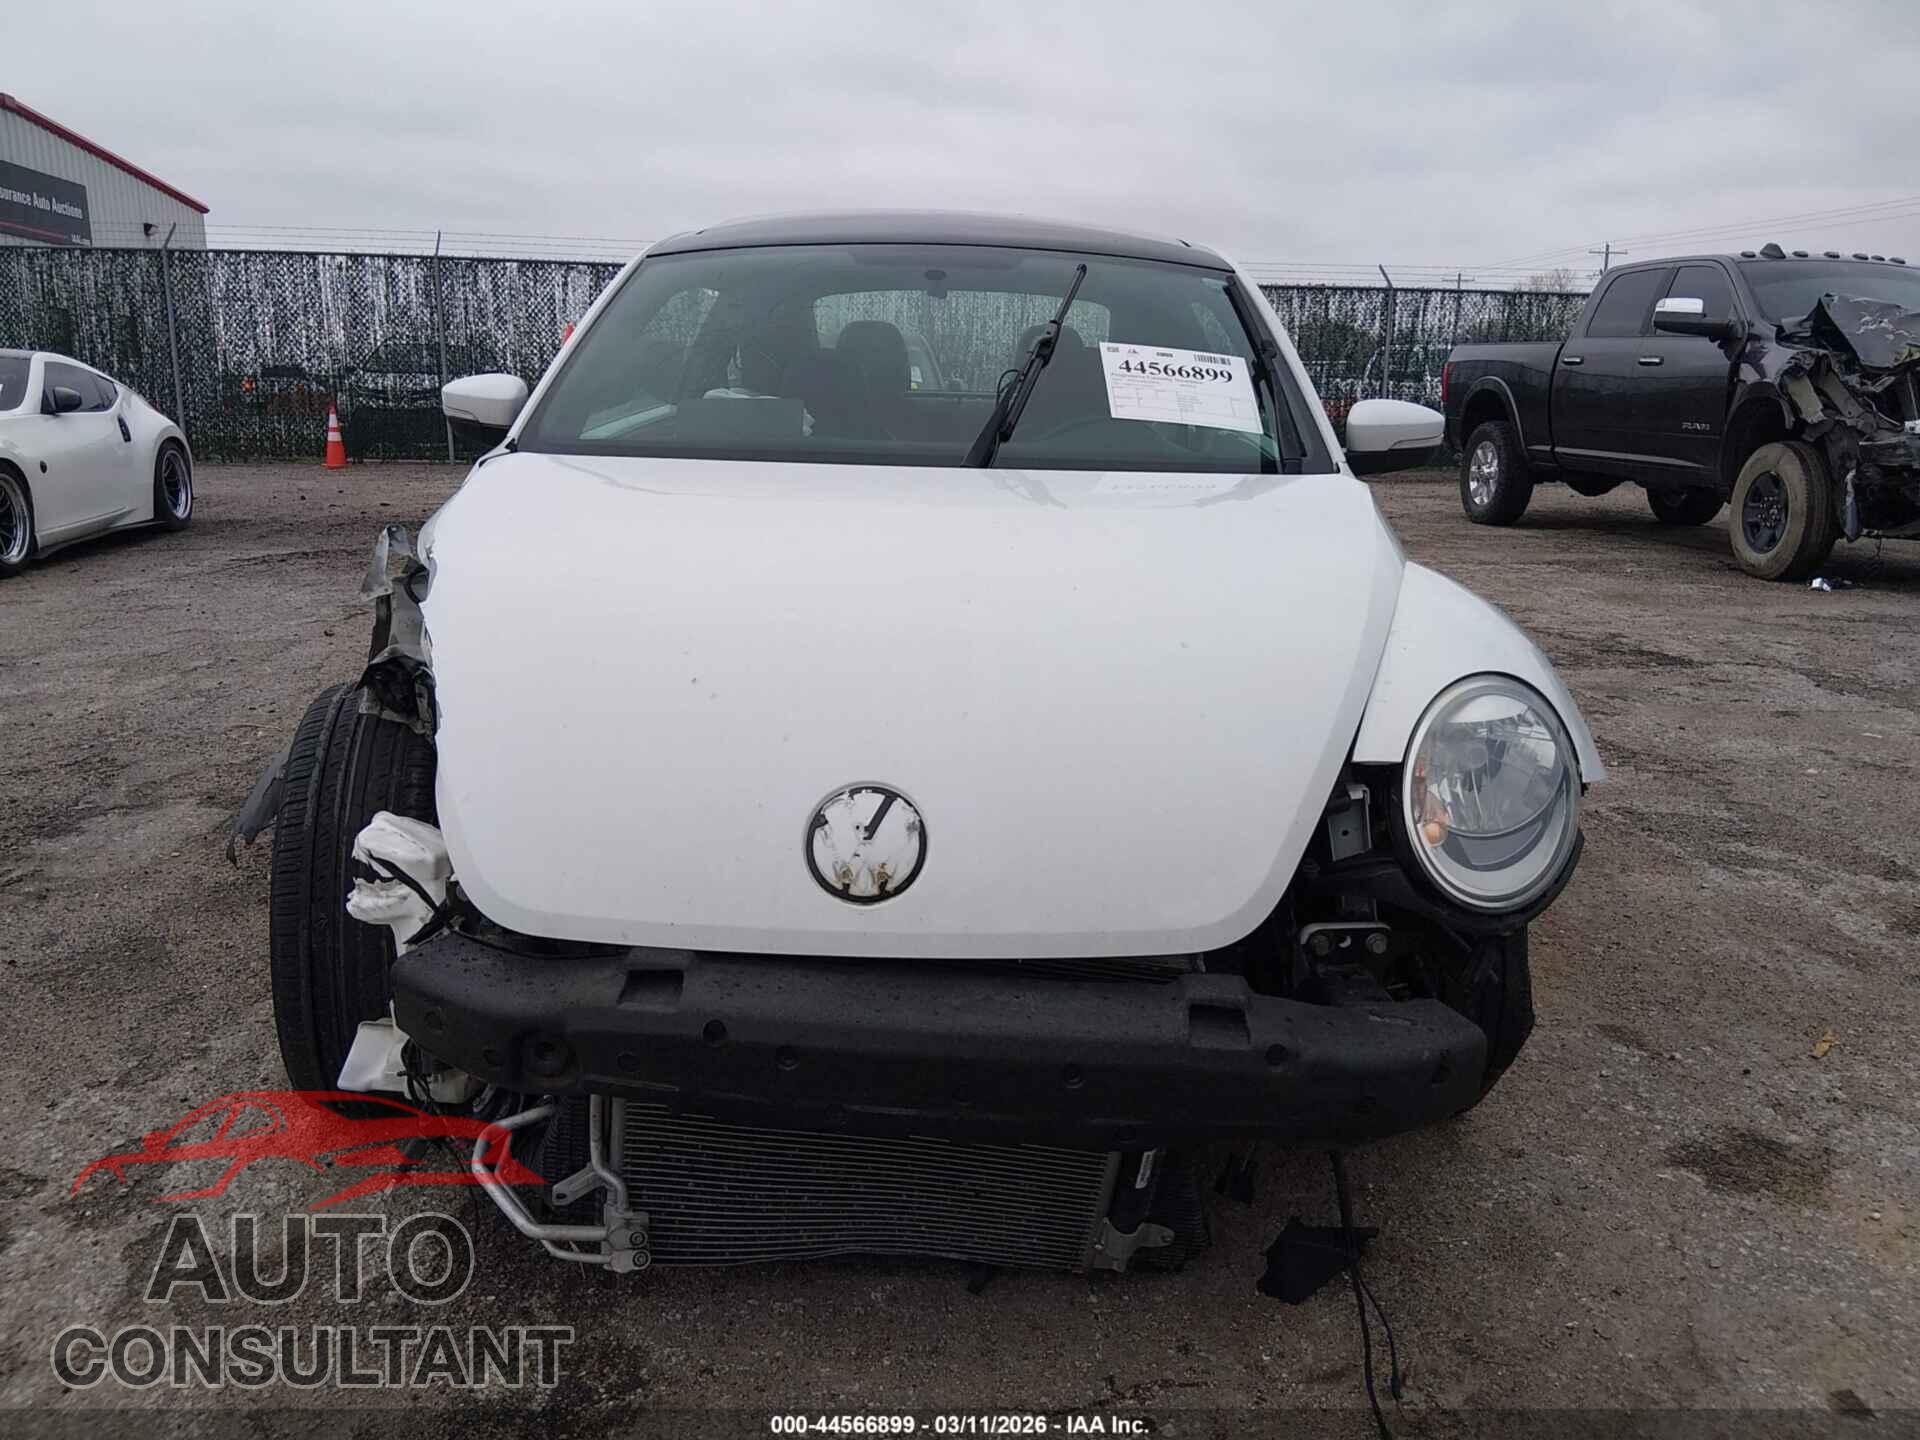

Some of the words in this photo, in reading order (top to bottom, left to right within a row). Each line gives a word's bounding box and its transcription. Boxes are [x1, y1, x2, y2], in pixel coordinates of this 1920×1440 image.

[33, 192, 51, 211] Auto
[52, 197, 83, 219] Auctions
[1118, 359, 1233, 384] 44566899
